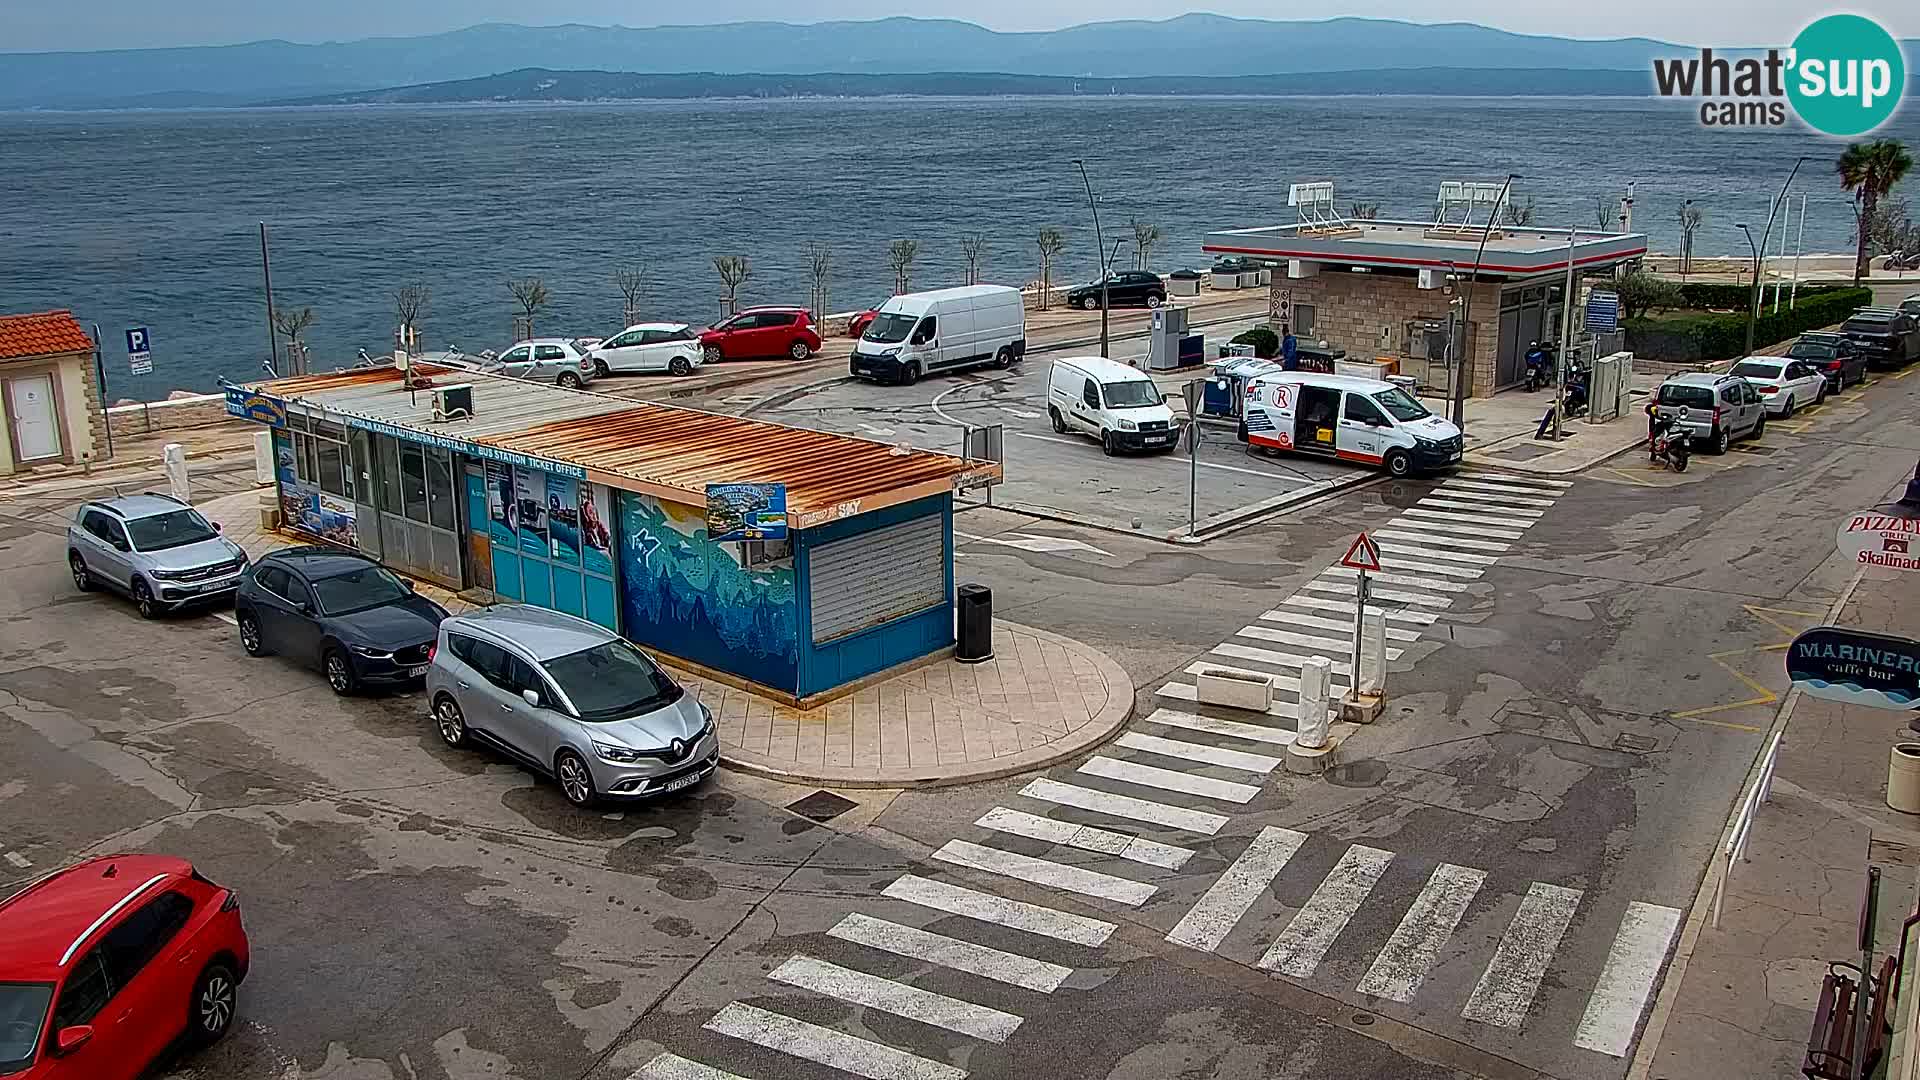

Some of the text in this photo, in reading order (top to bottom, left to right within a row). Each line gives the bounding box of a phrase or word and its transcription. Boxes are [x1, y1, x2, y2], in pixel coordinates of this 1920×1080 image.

[131, 331, 143, 350] P
[396, 427, 437, 445] AUTOBUSNA
[437, 438, 469, 453] POSTAJA
[478, 446, 494, 458] BUS
[494, 449, 526, 465] STATION
[526, 457, 555, 471] TICKET
[555, 462, 583, 477] OFFICE
[1880, 531, 1915, 541] GRILL
[1827, 663, 1896, 681] caffe bar
